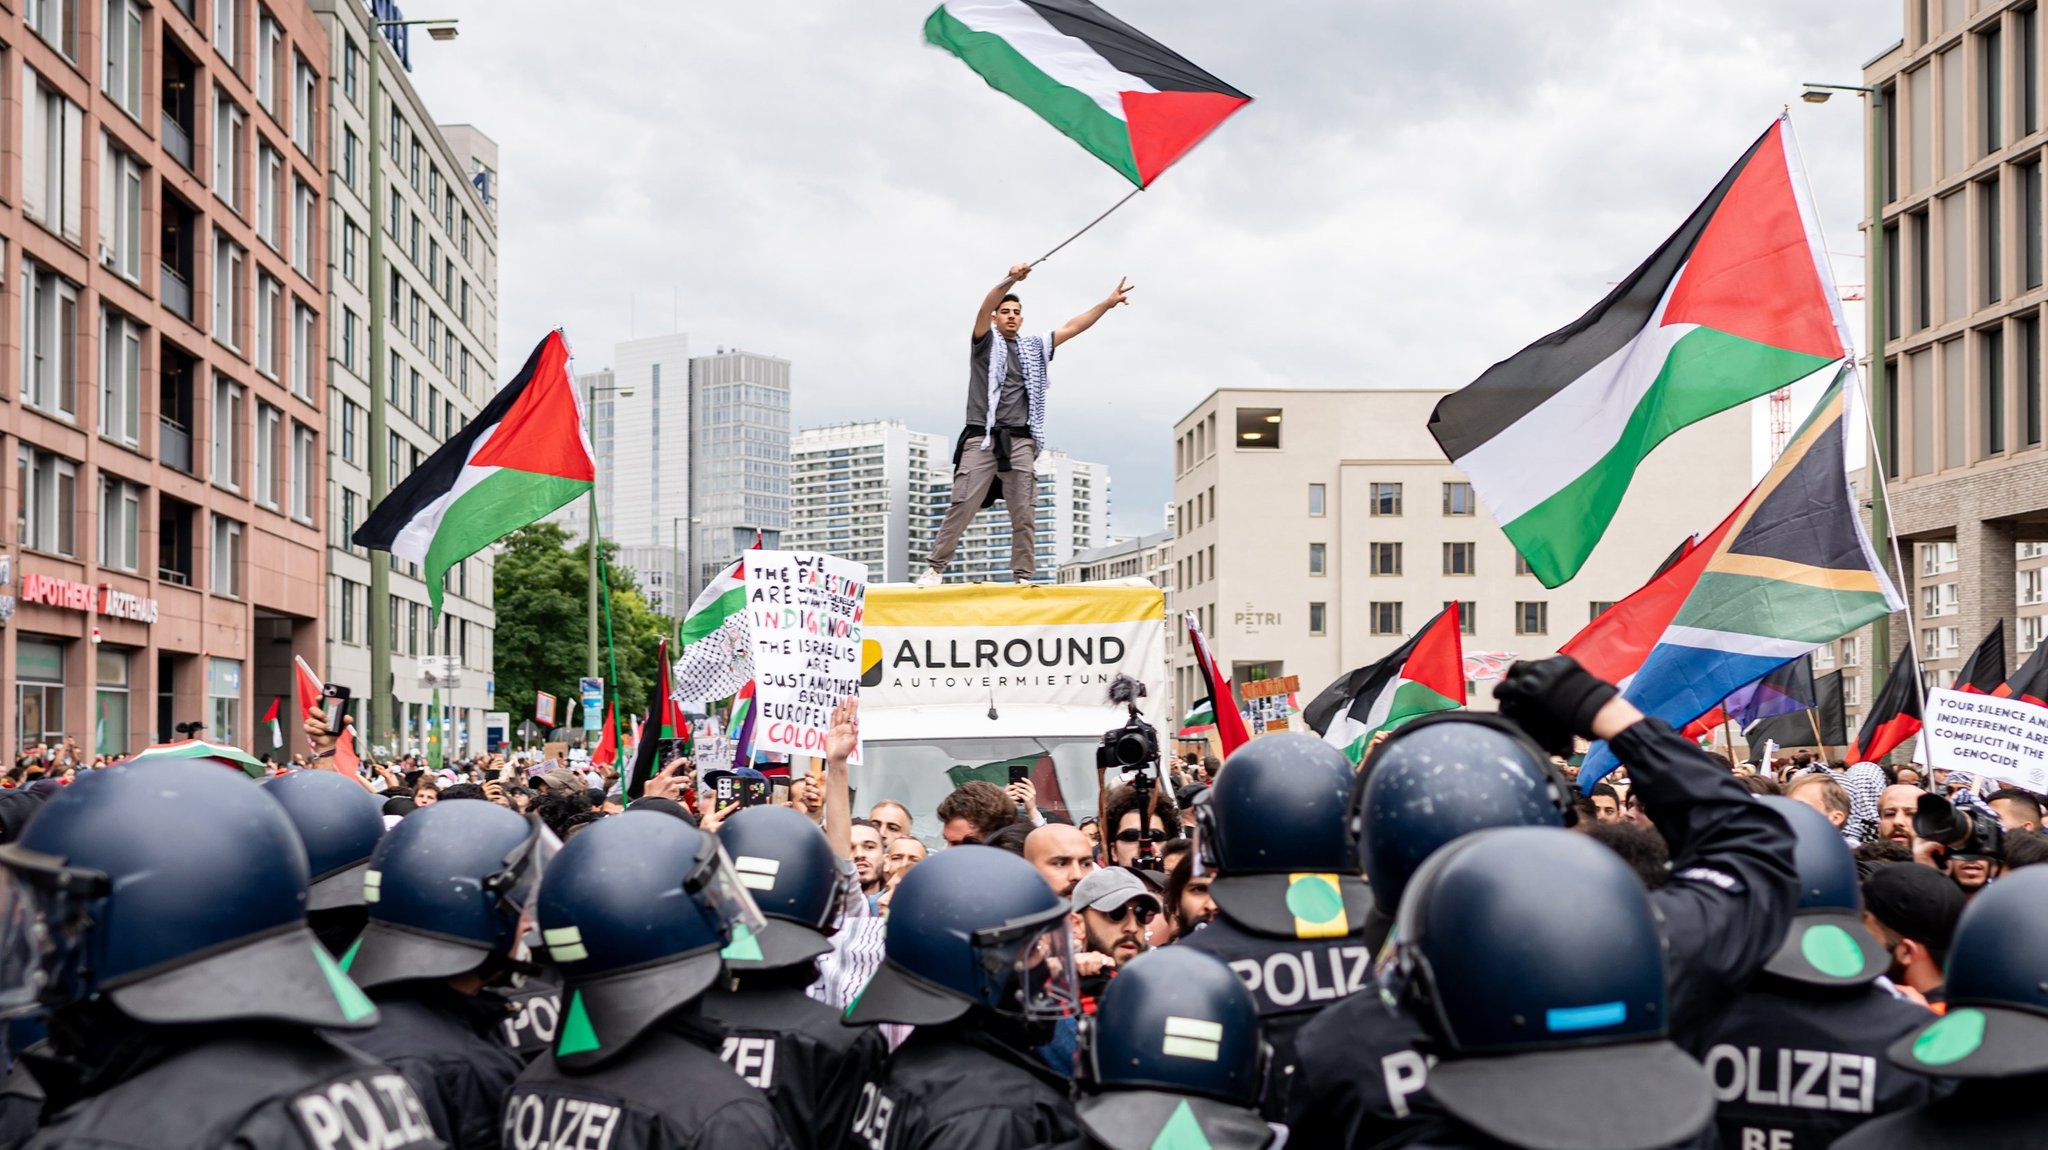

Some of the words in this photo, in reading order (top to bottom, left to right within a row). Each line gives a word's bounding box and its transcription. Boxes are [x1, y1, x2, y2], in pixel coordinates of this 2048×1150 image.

[754, 567, 790, 583] THE
[794, 555, 823, 573] WE
[24, 573, 97, 612] APOTHEKE
[752, 586, 792, 605] ARE
[755, 608, 861, 643] INDIGENOUS
[1235, 612, 1282, 626] PETRI
[759, 639, 791, 655] THE
[799, 639, 856, 663] ISRAELIS
[892, 635, 1126, 669] ALLROUND
[806, 657, 830, 673] ARE
[763, 673, 805, 688] JUST
[808, 676, 861, 698] ANOTHER
[893, 673, 1108, 688] AUTOVERMIETUN
[798, 689, 841, 708] BRUTA
[763, 702, 829, 728] EUROPEA
[1939, 697, 1974, 712] YOUR
[1977, 704, 2026, 722] SILENCE
[2029, 715, 2048, 730] AN
[1936, 713, 2023, 737] INDIFFERENCE
[2025, 731, 2048, 745] ARE
[1934, 728, 2004, 748] COMPLICIT
[2006, 741, 2020, 752] IN
[2023, 745, 2045, 760] THE
[1953, 747, 2019, 768] GENOCIDE
[1228, 946, 1371, 1006] POLIZ
[1704, 1043, 1877, 1113] OLIZEI
